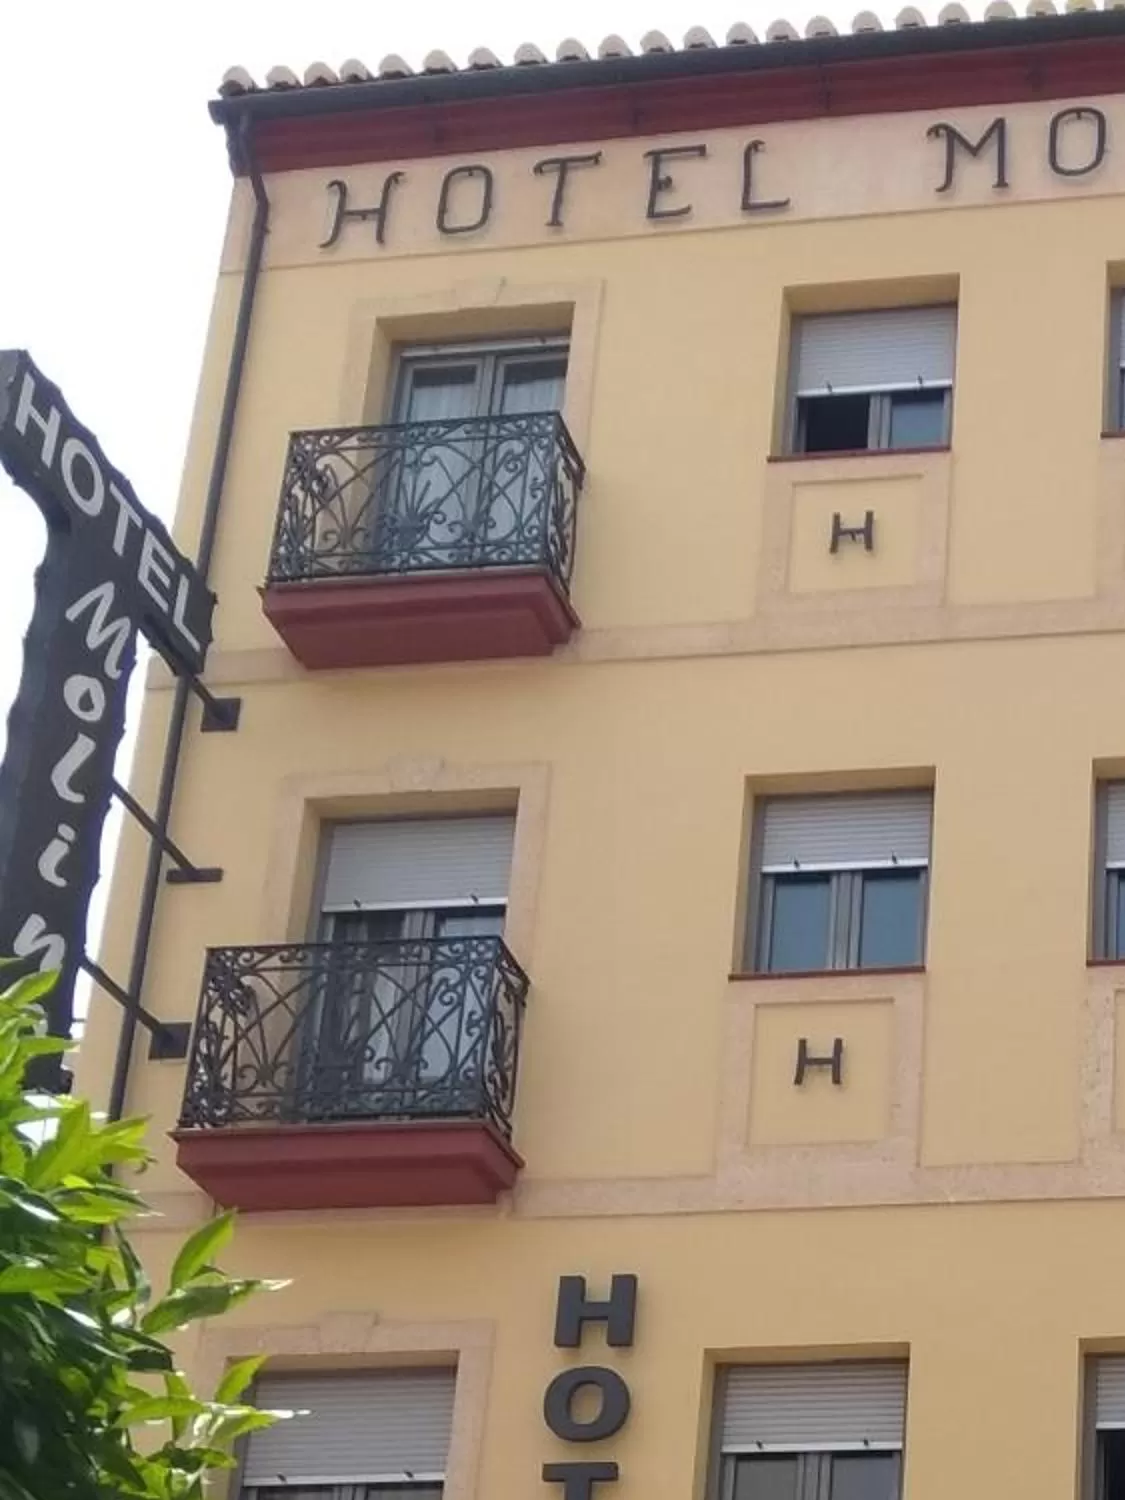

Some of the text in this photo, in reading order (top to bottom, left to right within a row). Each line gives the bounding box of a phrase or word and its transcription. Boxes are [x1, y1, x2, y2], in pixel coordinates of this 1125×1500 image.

[319, 138, 791, 250] HOTEL
[14, 371, 201, 652] HOTEL
[829, 510, 875, 555] H
[793, 1037, 844, 1086] H
